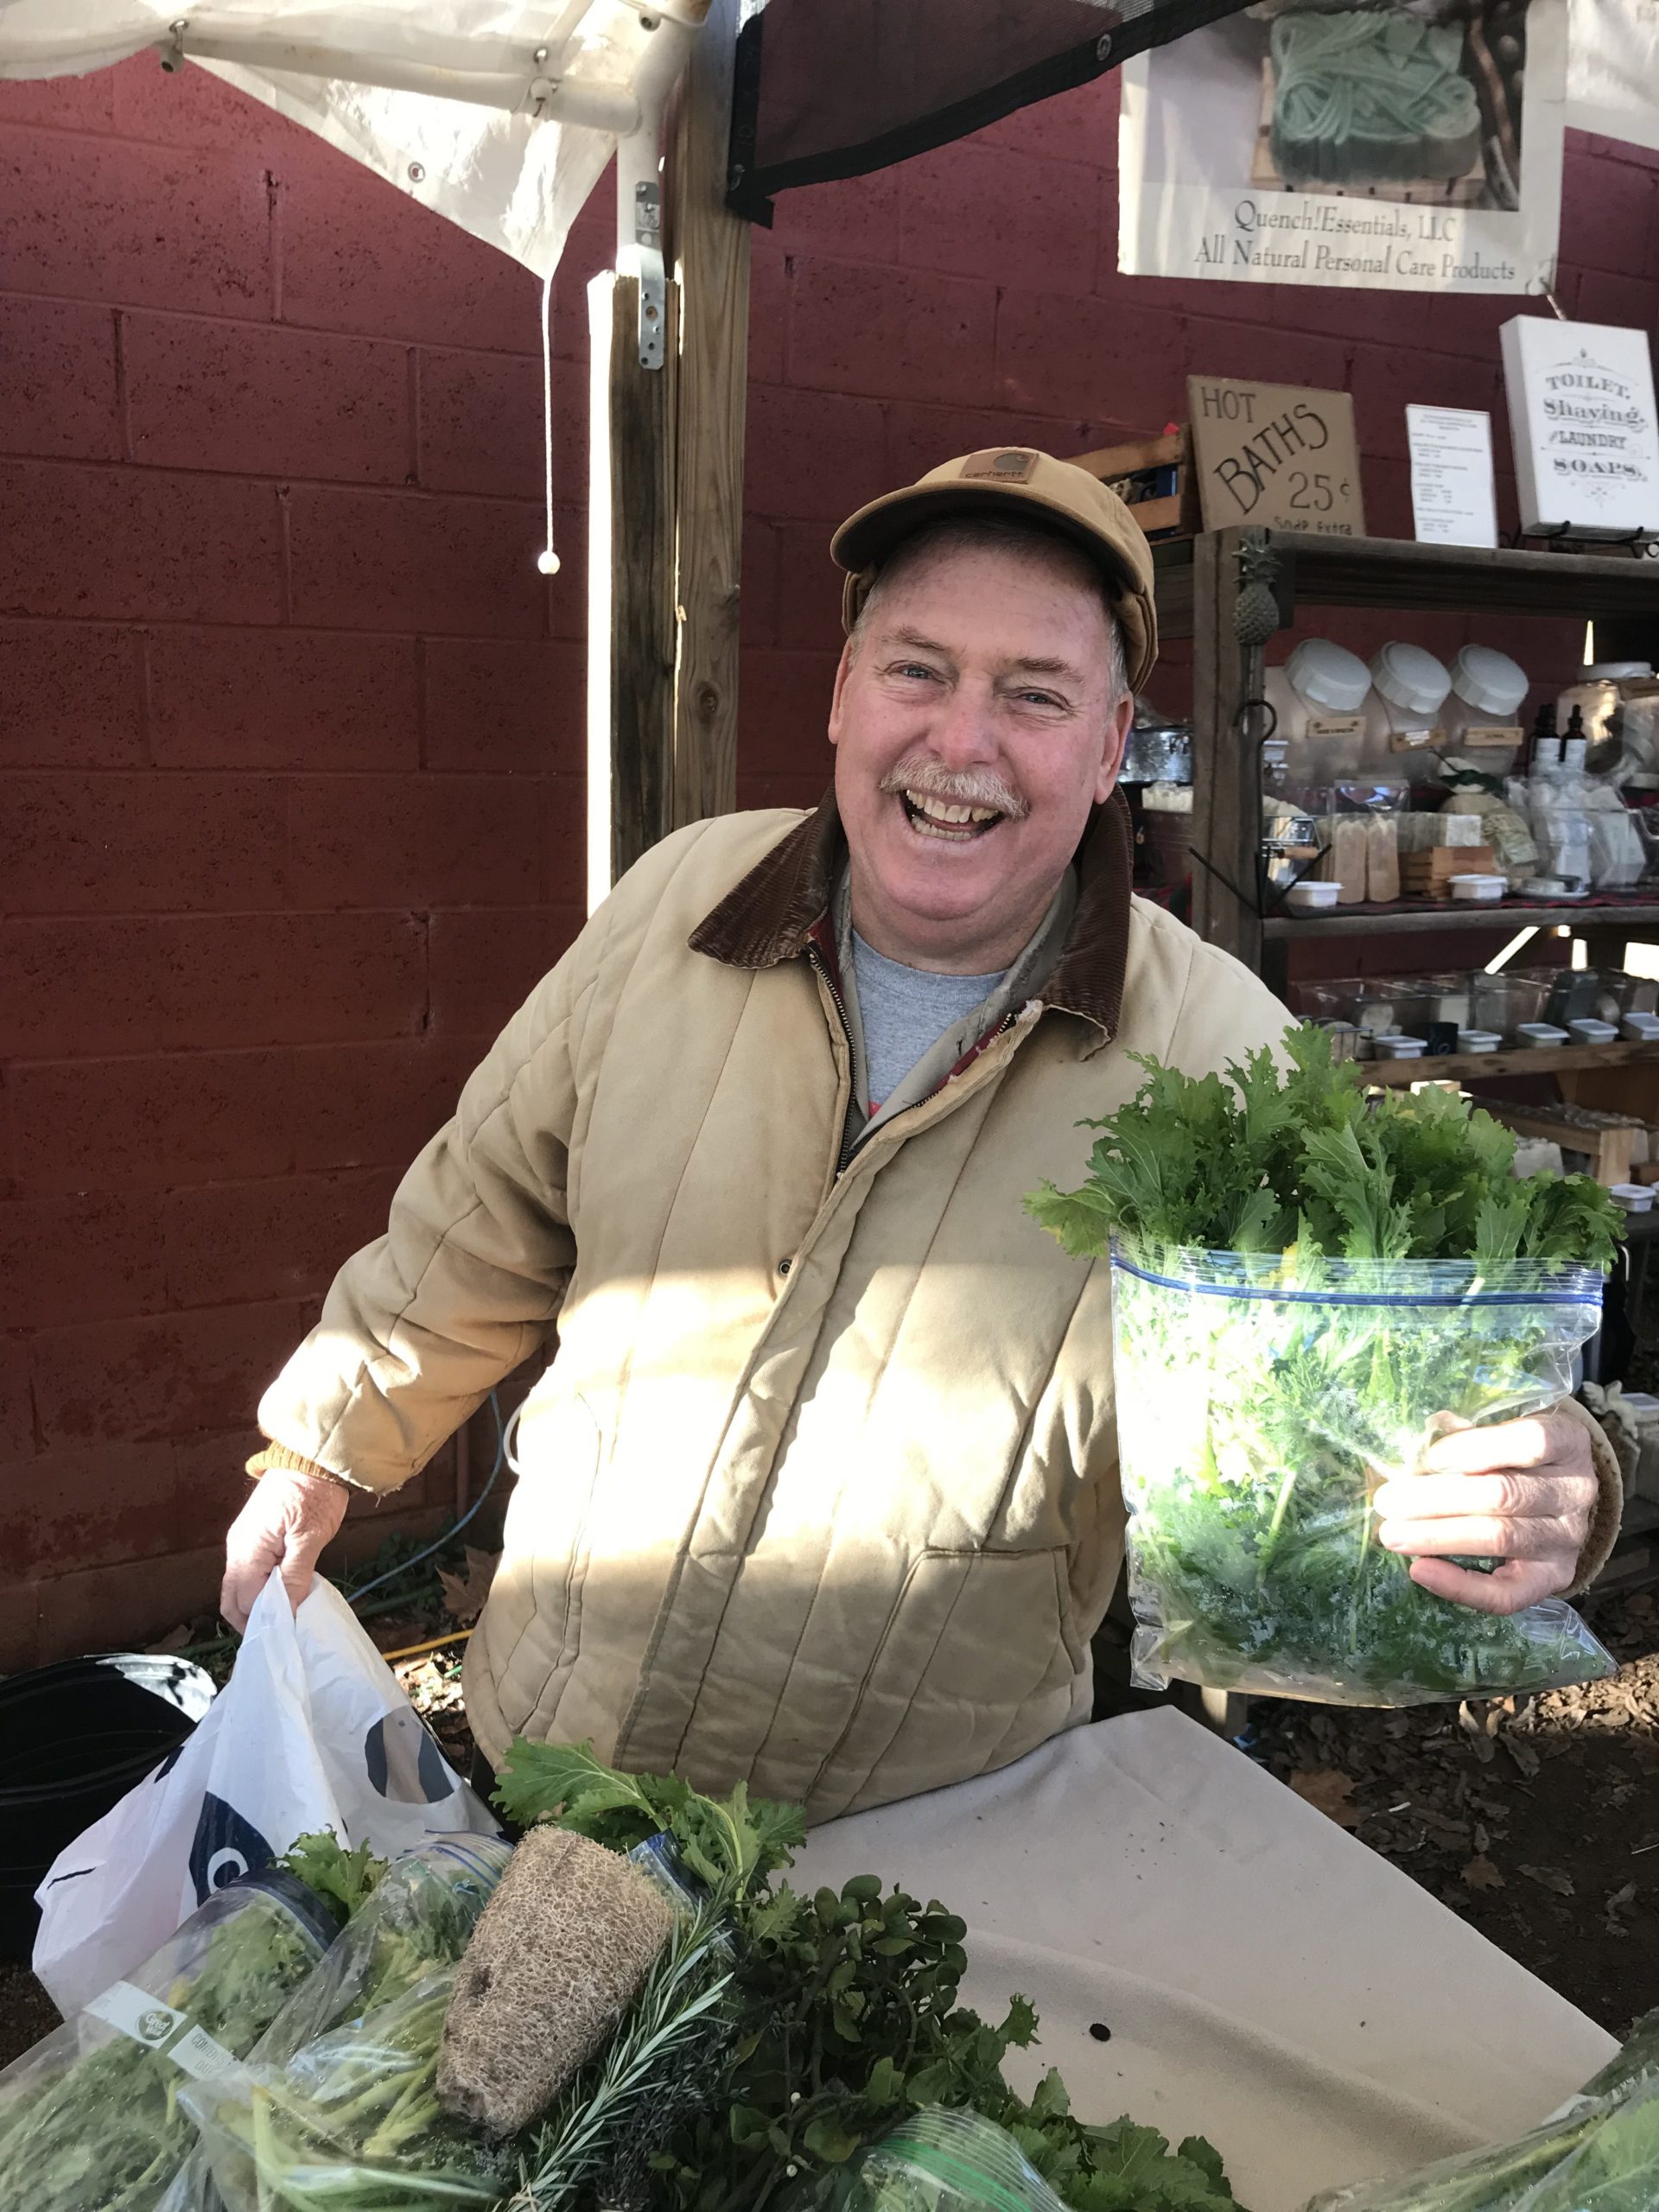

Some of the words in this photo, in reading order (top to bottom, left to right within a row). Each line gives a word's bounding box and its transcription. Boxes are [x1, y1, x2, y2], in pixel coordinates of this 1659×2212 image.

[1417, 214, 1456, 243] LLC
[1193, 233, 1225, 264] All
[1232, 239, 1310, 269] Natural
[1313, 244, 1393, 274] Personal
[1395, 250, 1438, 277] Care
[1440, 251, 1516, 281] Products
[1201, 386, 1256, 423] HOT
[1559, 430, 1627, 449] LAUNDRY
[1212, 403, 1329, 516] BATHS
